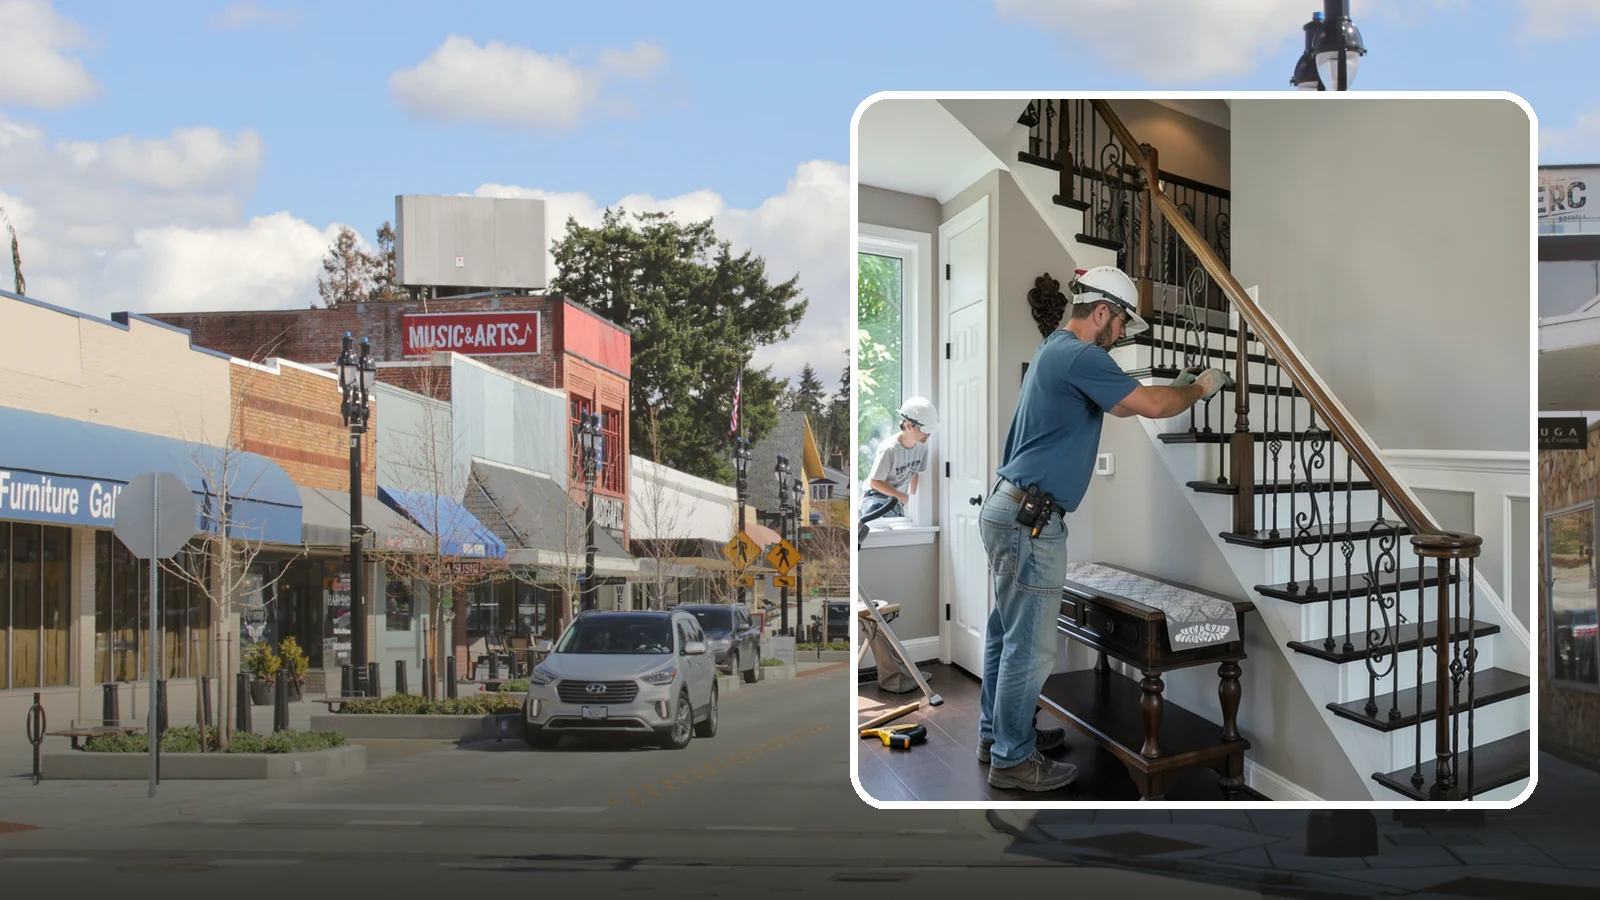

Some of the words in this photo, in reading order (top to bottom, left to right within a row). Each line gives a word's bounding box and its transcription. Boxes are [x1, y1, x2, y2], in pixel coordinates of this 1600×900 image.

[409, 323, 519, 349] MUSIC&ARTS
[0, 471, 79, 515] Furniture
[453, 563, 479, 574] SUSHI
